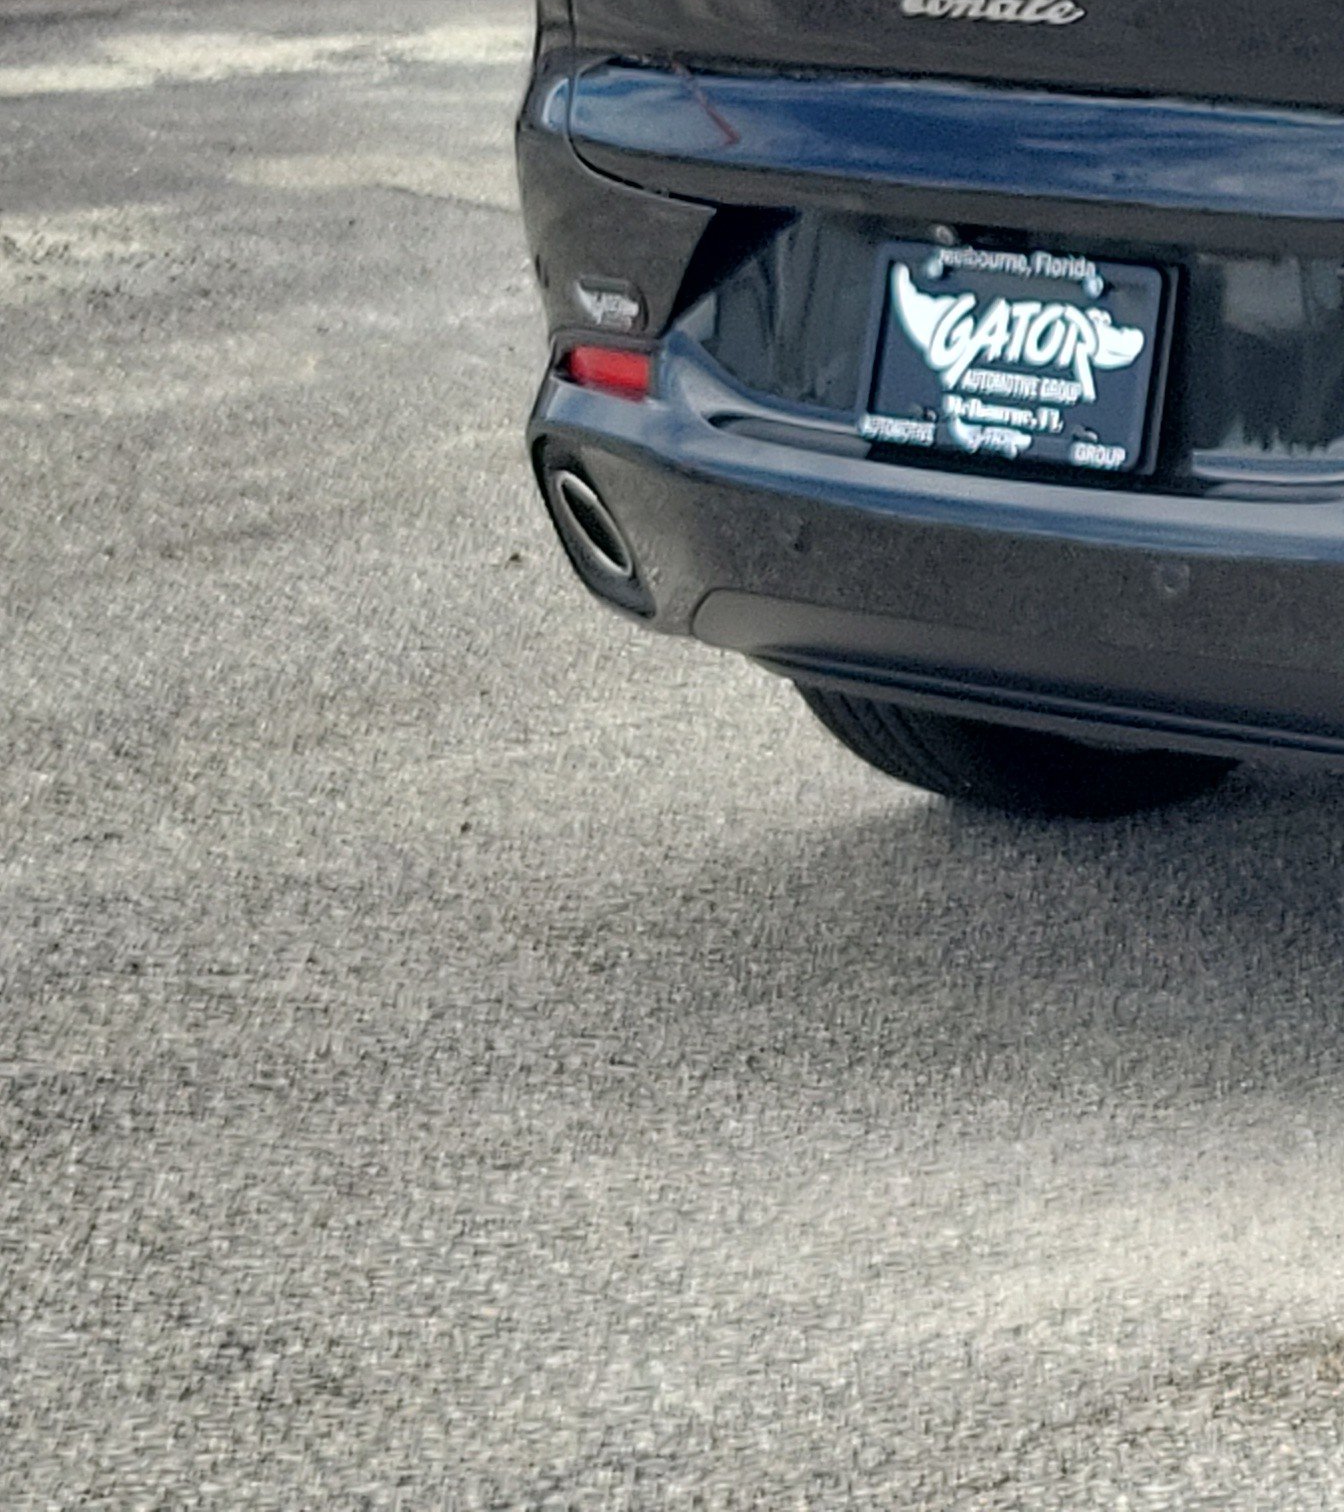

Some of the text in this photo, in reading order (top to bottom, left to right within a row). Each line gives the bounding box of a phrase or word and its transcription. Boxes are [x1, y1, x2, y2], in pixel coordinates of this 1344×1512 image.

[1035, 251, 1096, 280] Florida
[929, 293, 1098, 402] GATOR
[961, 368, 1082, 405] AUTOMOTIVE GROUP
[1073, 443, 1126, 469] GROUP
